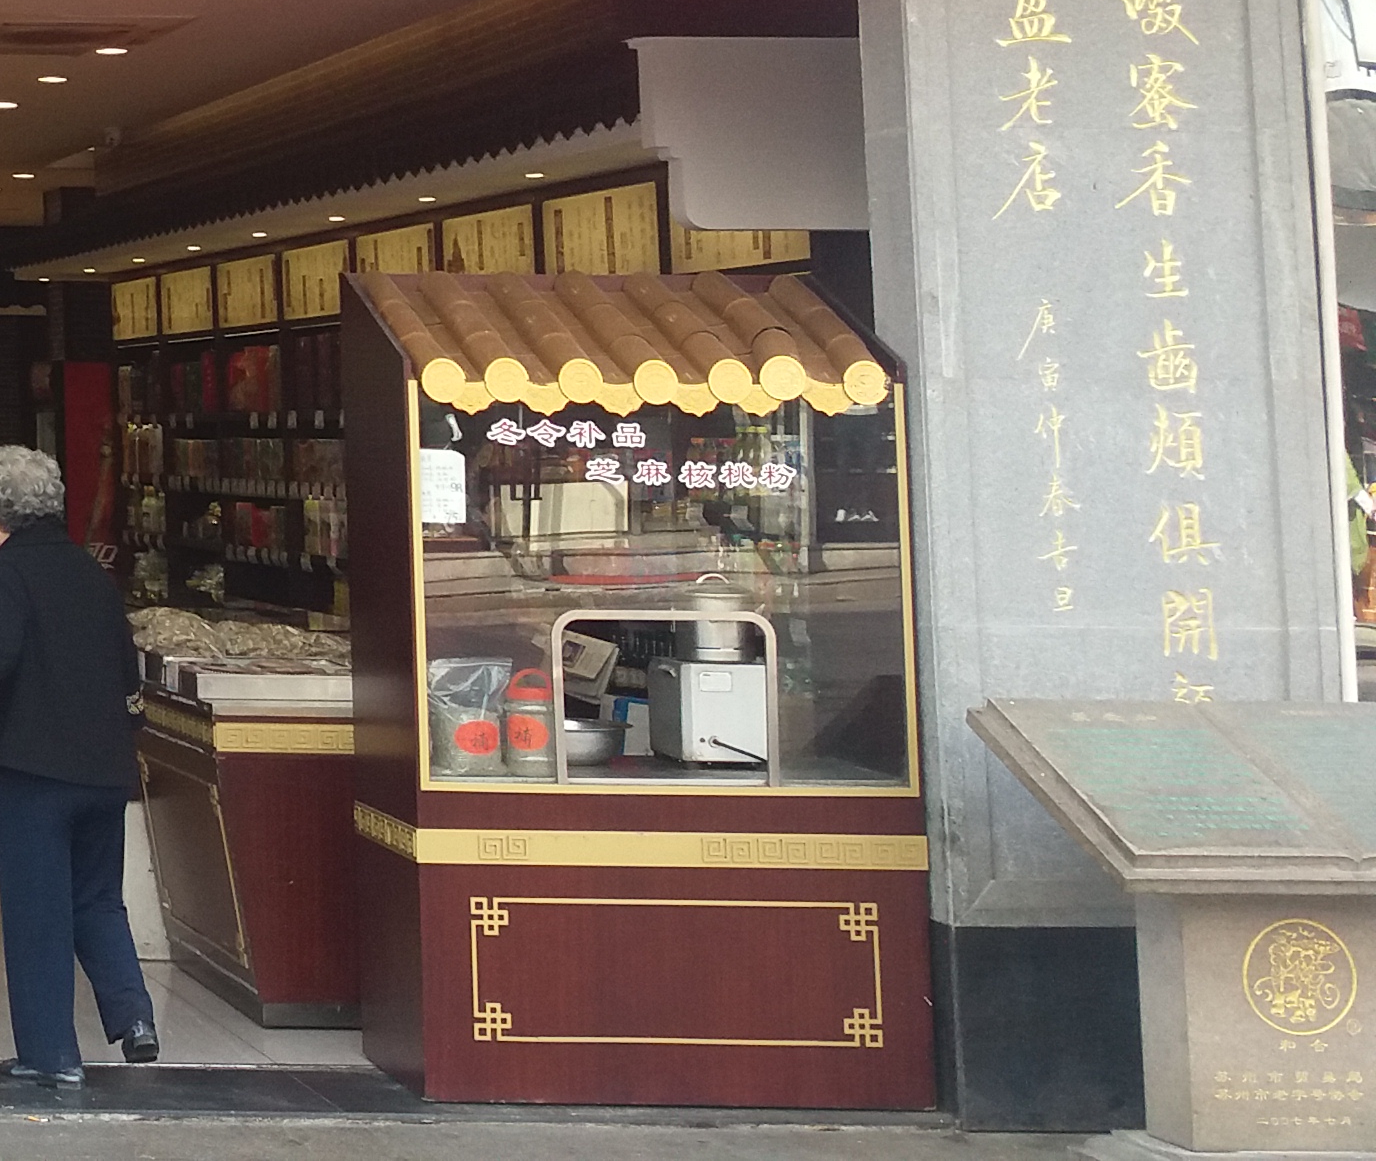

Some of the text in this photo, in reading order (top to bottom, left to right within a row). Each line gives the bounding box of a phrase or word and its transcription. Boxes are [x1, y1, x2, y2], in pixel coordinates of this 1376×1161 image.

[486, 419, 647, 449] 冬令补品
[584, 458, 798, 490] 芝麻核桃粉
